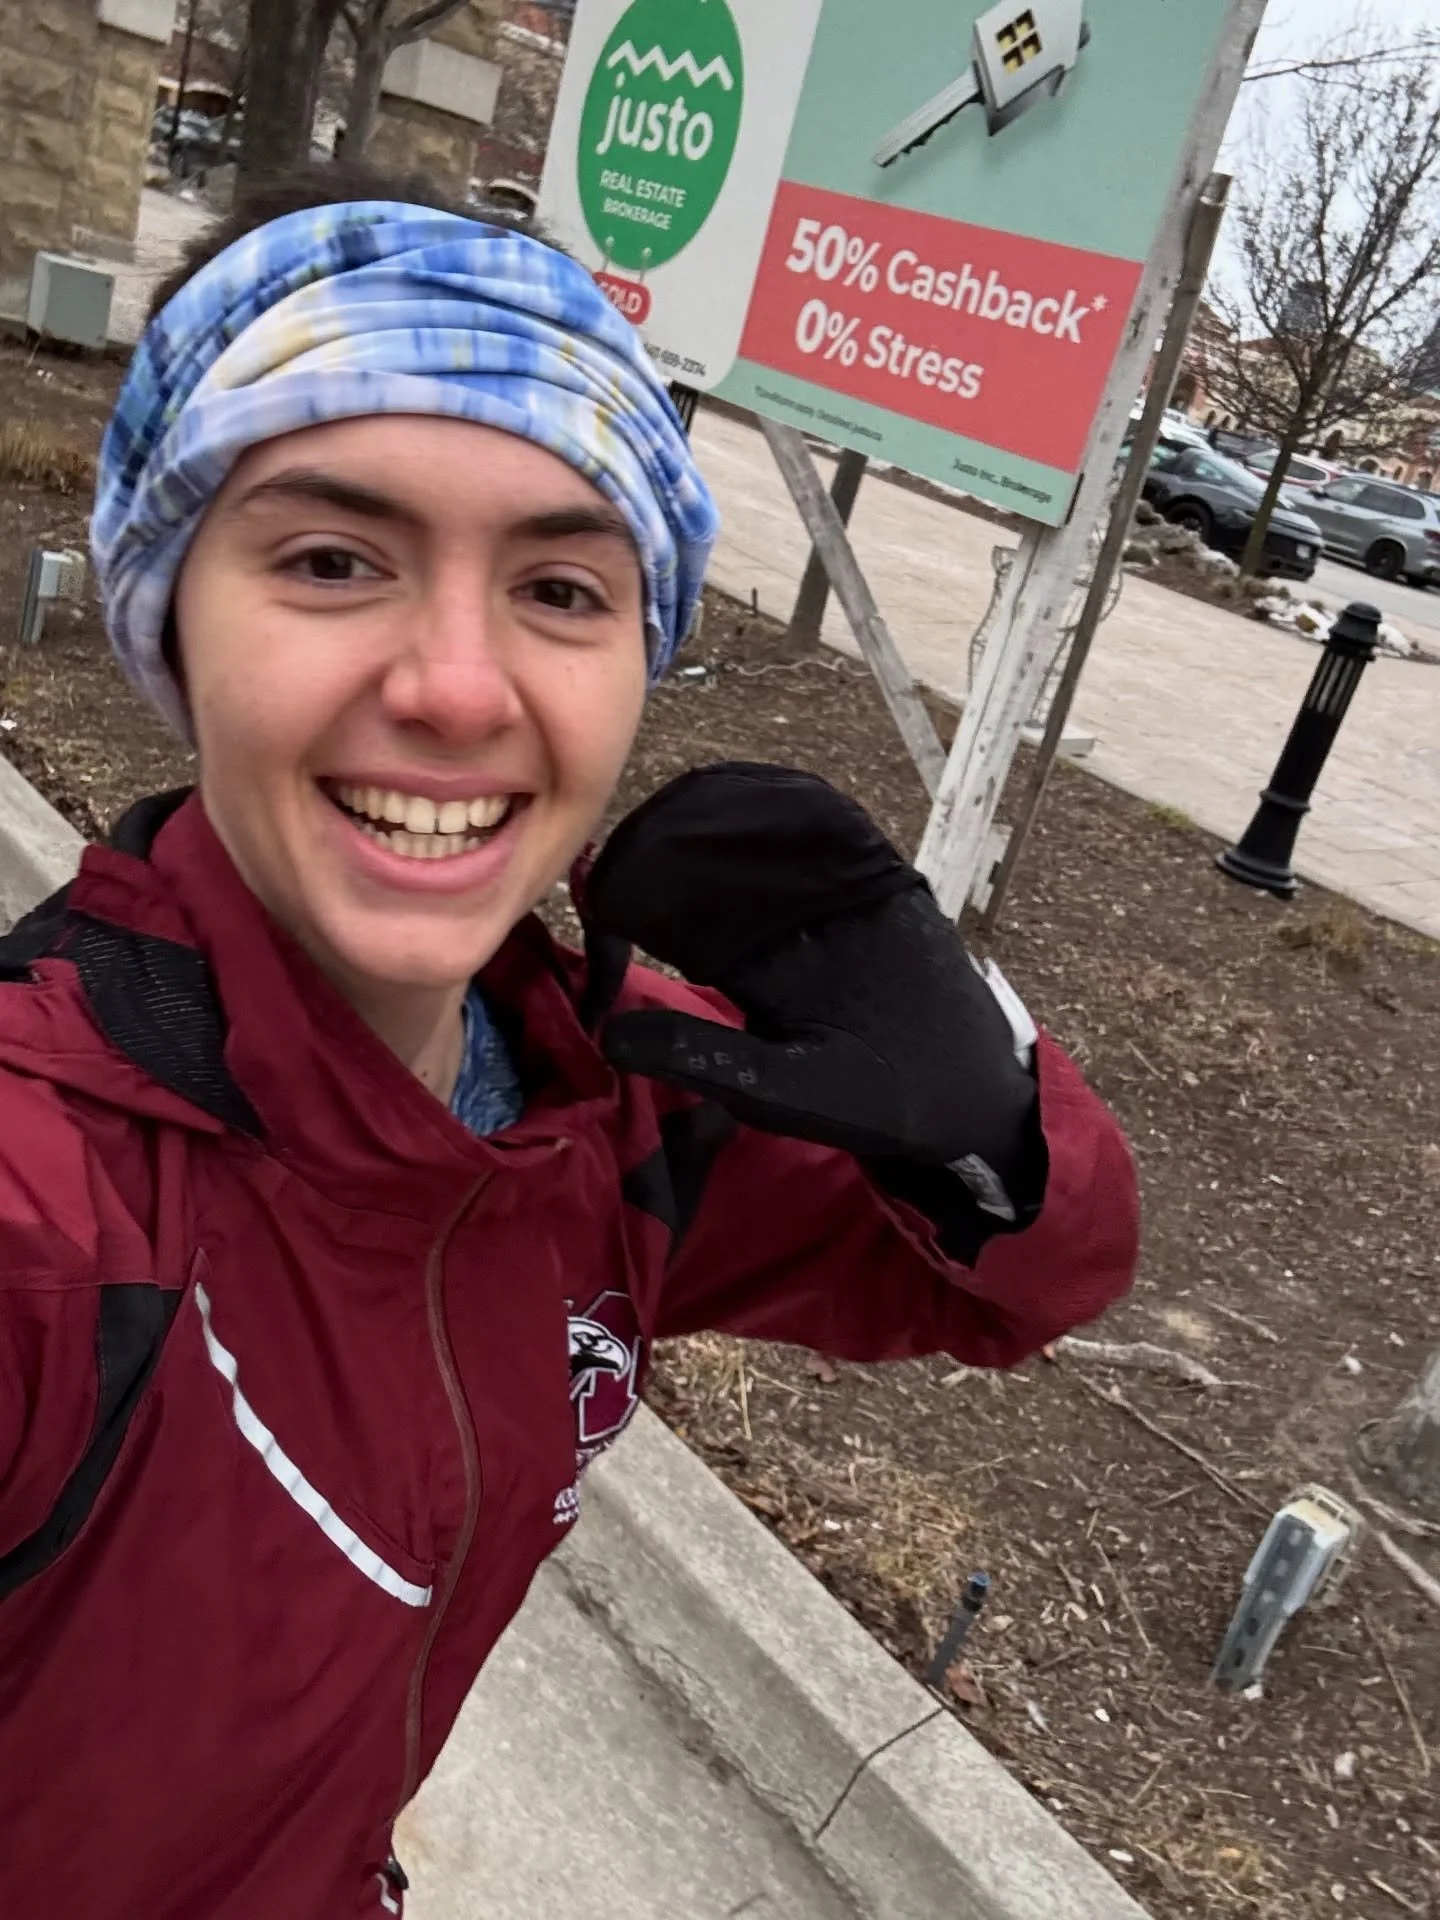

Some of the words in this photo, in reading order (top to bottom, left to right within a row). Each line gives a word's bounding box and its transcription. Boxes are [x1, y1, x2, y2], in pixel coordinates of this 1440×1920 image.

[595, 72, 714, 161] justo
[600, 169, 633, 195] REAL
[636, 179, 687, 208] ESTATE
[603, 197, 673, 230] BROKERAGE
[785, 218, 882, 293] 50%
[599, 281, 642, 315] OLD
[795, 299, 861, 368] 0%
[863, 325, 985, 400] Stress
